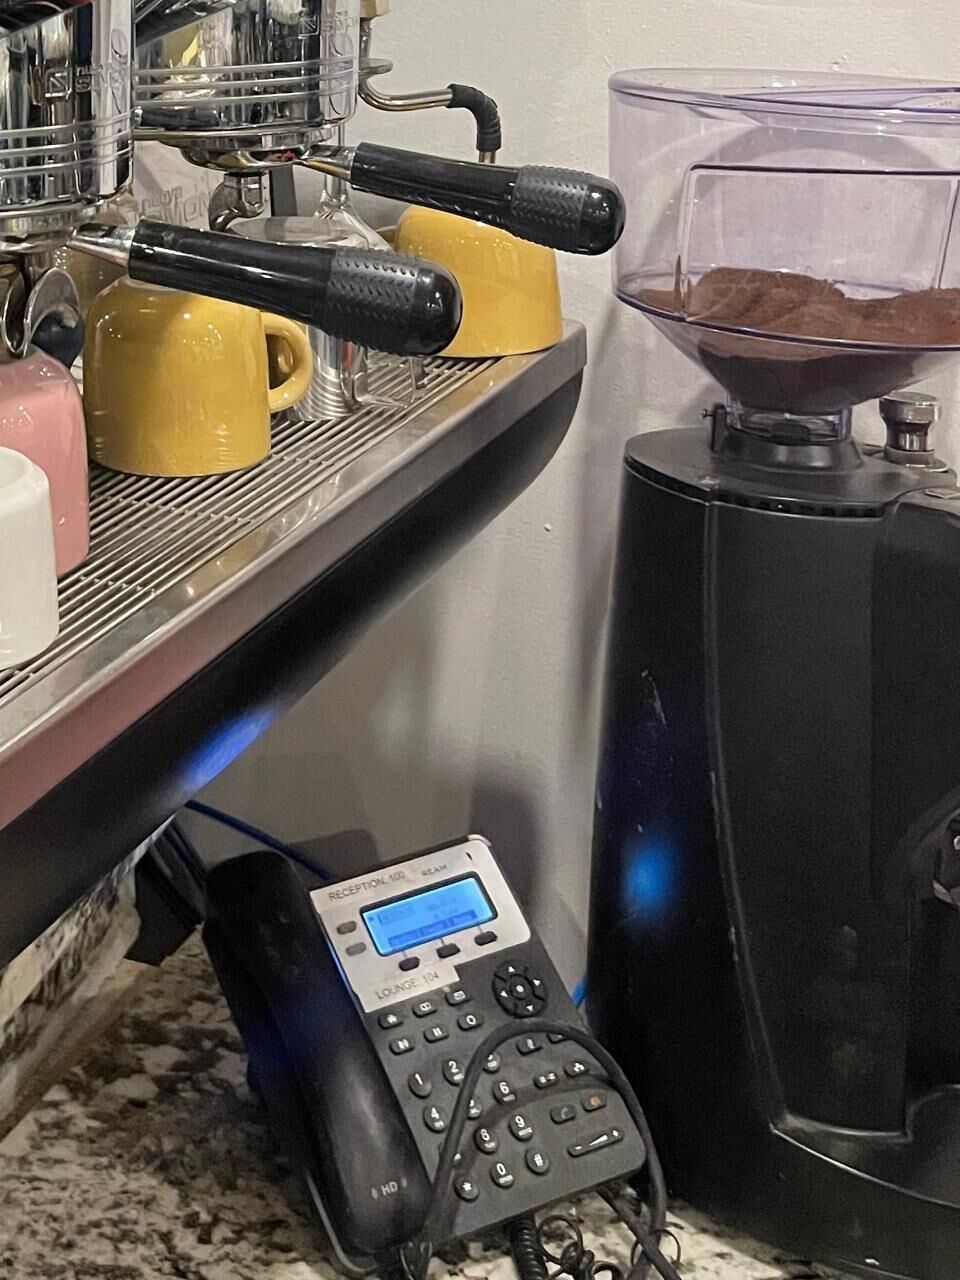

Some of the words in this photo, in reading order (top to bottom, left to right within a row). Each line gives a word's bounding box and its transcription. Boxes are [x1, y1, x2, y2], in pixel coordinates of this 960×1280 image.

[448, 1060, 459, 1073] 2
[499, 1081, 510, 1094] 6
[515, 1115, 526, 1128] 9
[380, 1181, 398, 1196] HD
